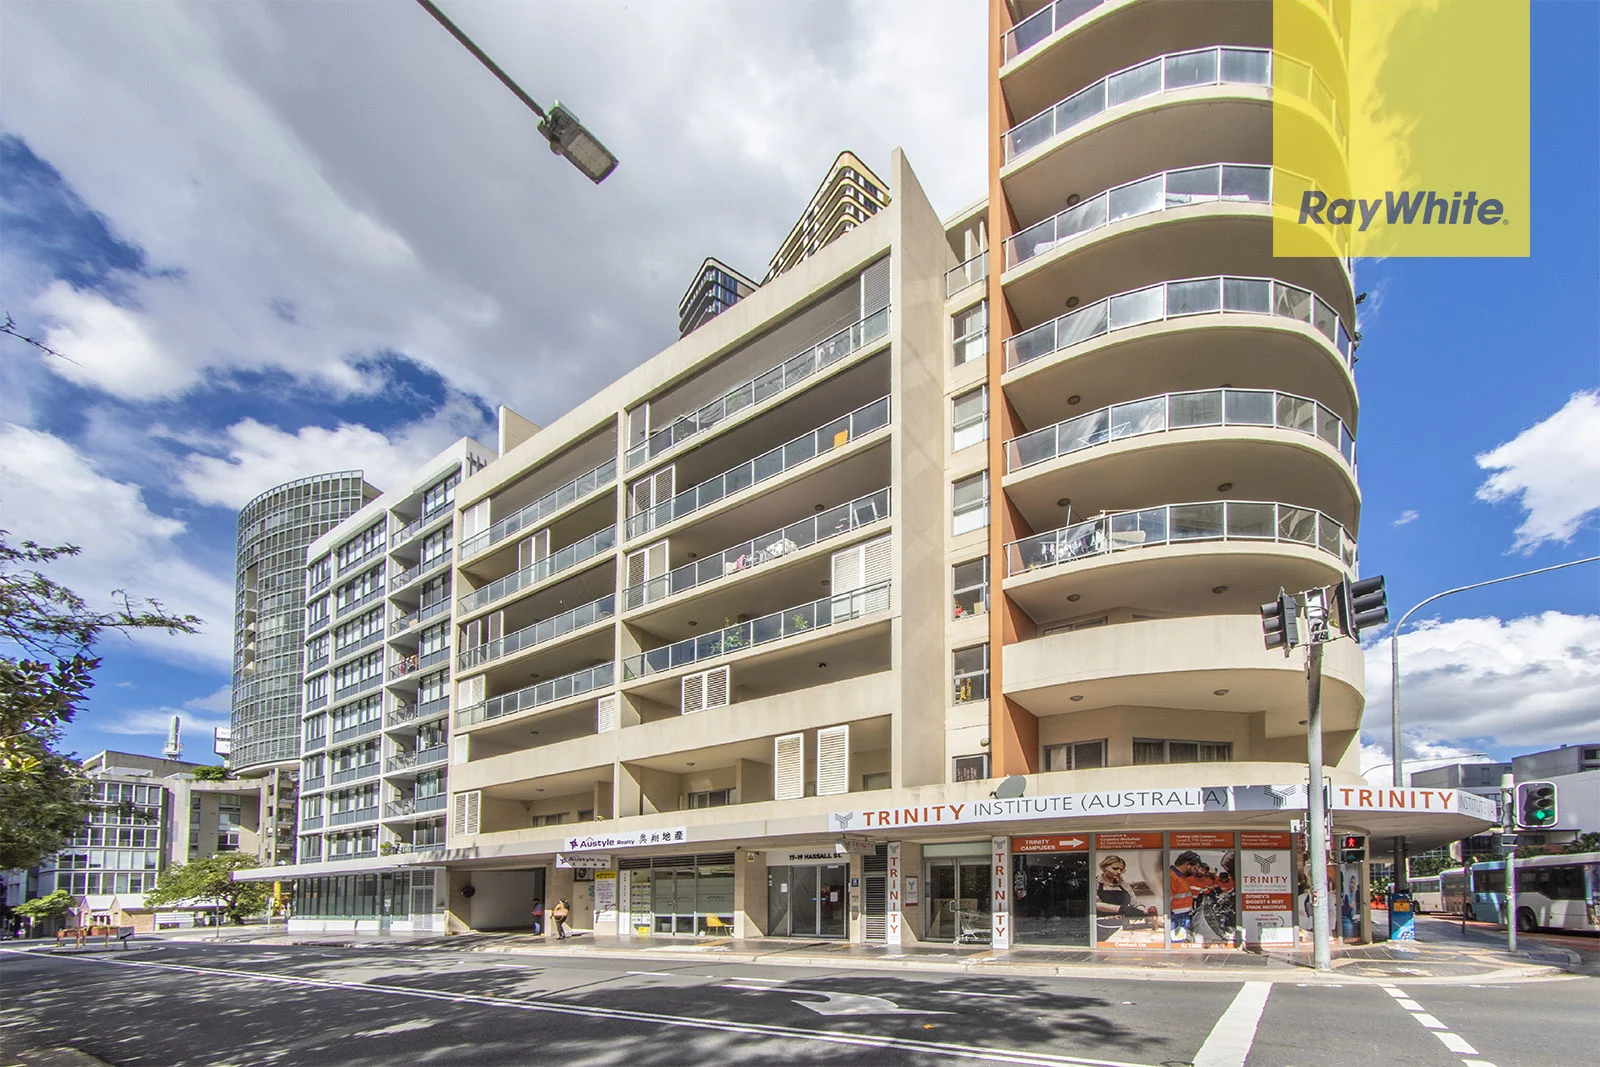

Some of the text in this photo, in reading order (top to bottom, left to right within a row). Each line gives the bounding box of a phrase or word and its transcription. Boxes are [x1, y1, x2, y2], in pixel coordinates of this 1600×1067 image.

[862, 789, 1228, 827] TRINITY INSTITUTE (AUSTRALIA)
[1339, 788, 1453, 810] TRINITY
[580, 837, 614, 848] Austyle
[995, 853, 1005, 937] TRINITY
[1243, 876, 1288, 884] TRINITY
[890, 857, 899, 934] TRINITY
